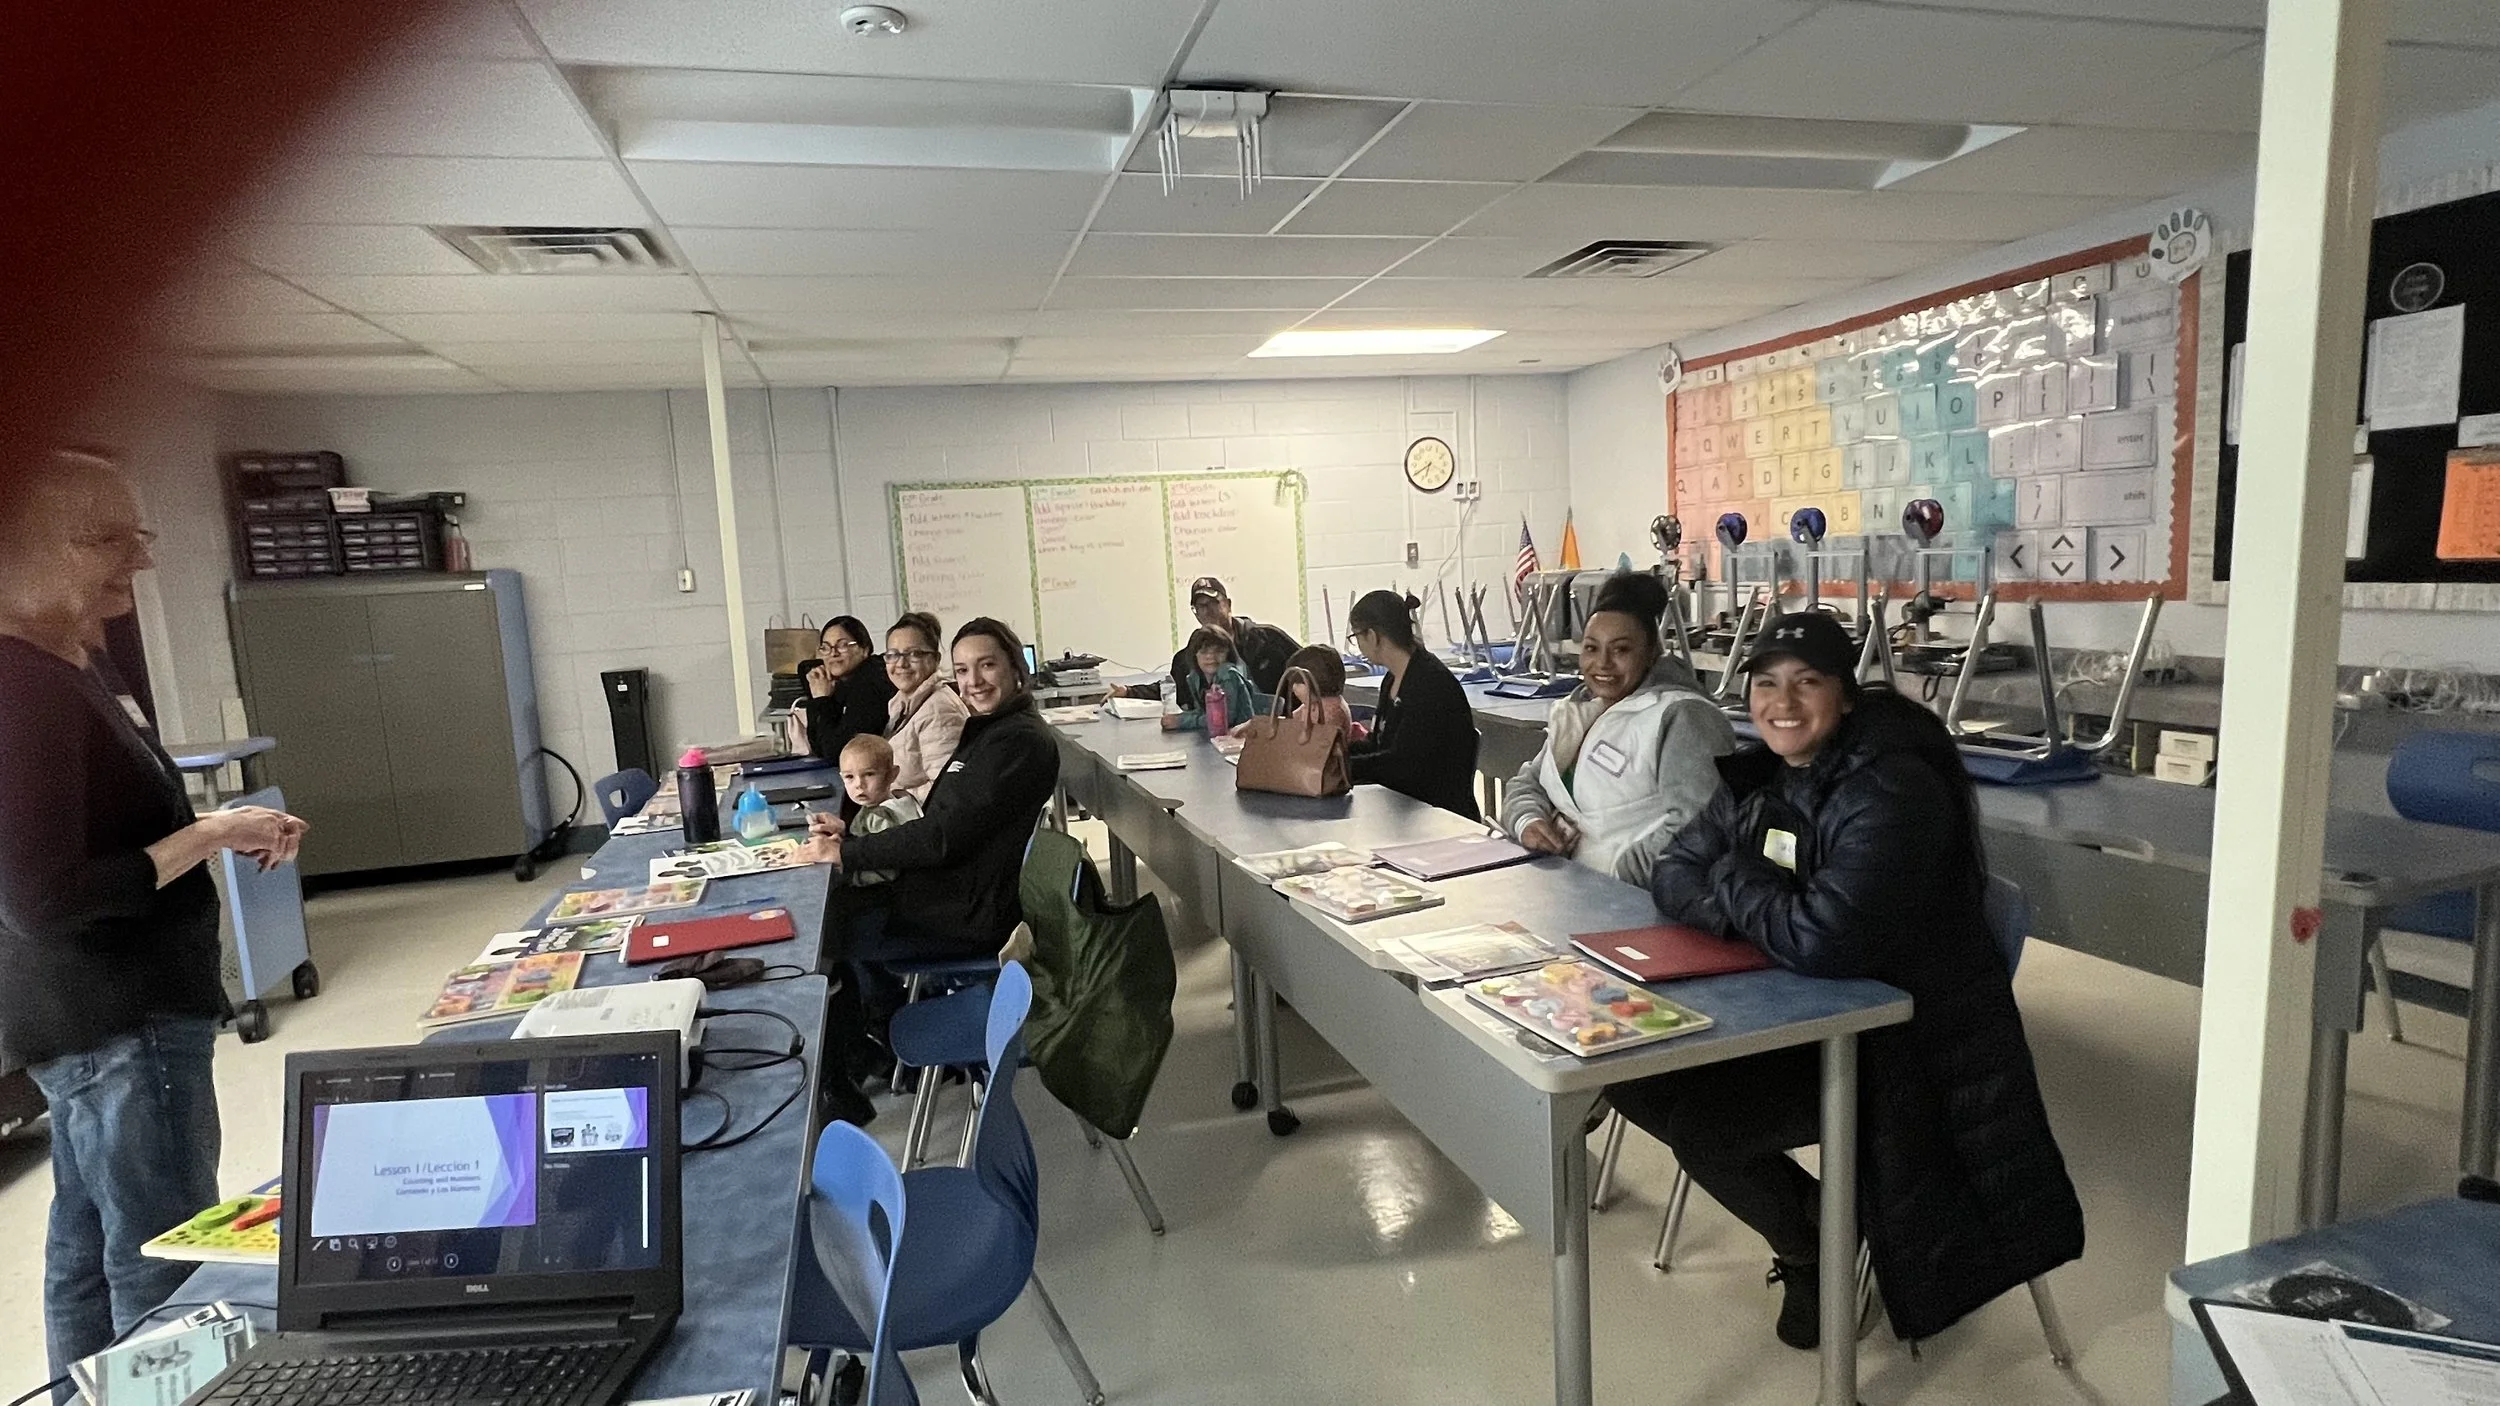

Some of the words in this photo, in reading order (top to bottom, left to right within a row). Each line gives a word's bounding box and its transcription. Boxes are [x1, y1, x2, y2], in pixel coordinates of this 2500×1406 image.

[1797, 389, 1805, 402] 5
[1828, 382, 1836, 395] 6
[1703, 438, 1713, 451] Q
[1726, 434, 1739, 449] W
[1755, 431, 1763, 444] E
[1782, 426, 1791, 440] R
[1811, 420, 1821, 435] T
[1843, 415, 1851, 431] Y
[1876, 407, 1887, 425] U
[1950, 397, 1963, 415] O
[1993, 391, 2004, 408] P
[1711, 476, 1720, 490] A
[1737, 473, 1745, 488] S
[1763, 470, 1773, 485] D
[1792, 467, 1801, 483] F
[1821, 463, 1831, 479] G
[1853, 460, 1863, 476] H
[1888, 455, 1896, 473] J
[1925, 452, 1935, 469] K
[1966, 447, 1975, 465] L
[1840, 506, 1849, 521] B
[1873, 503, 1885, 520] N
[373, 1163, 411, 1177] Lesson
